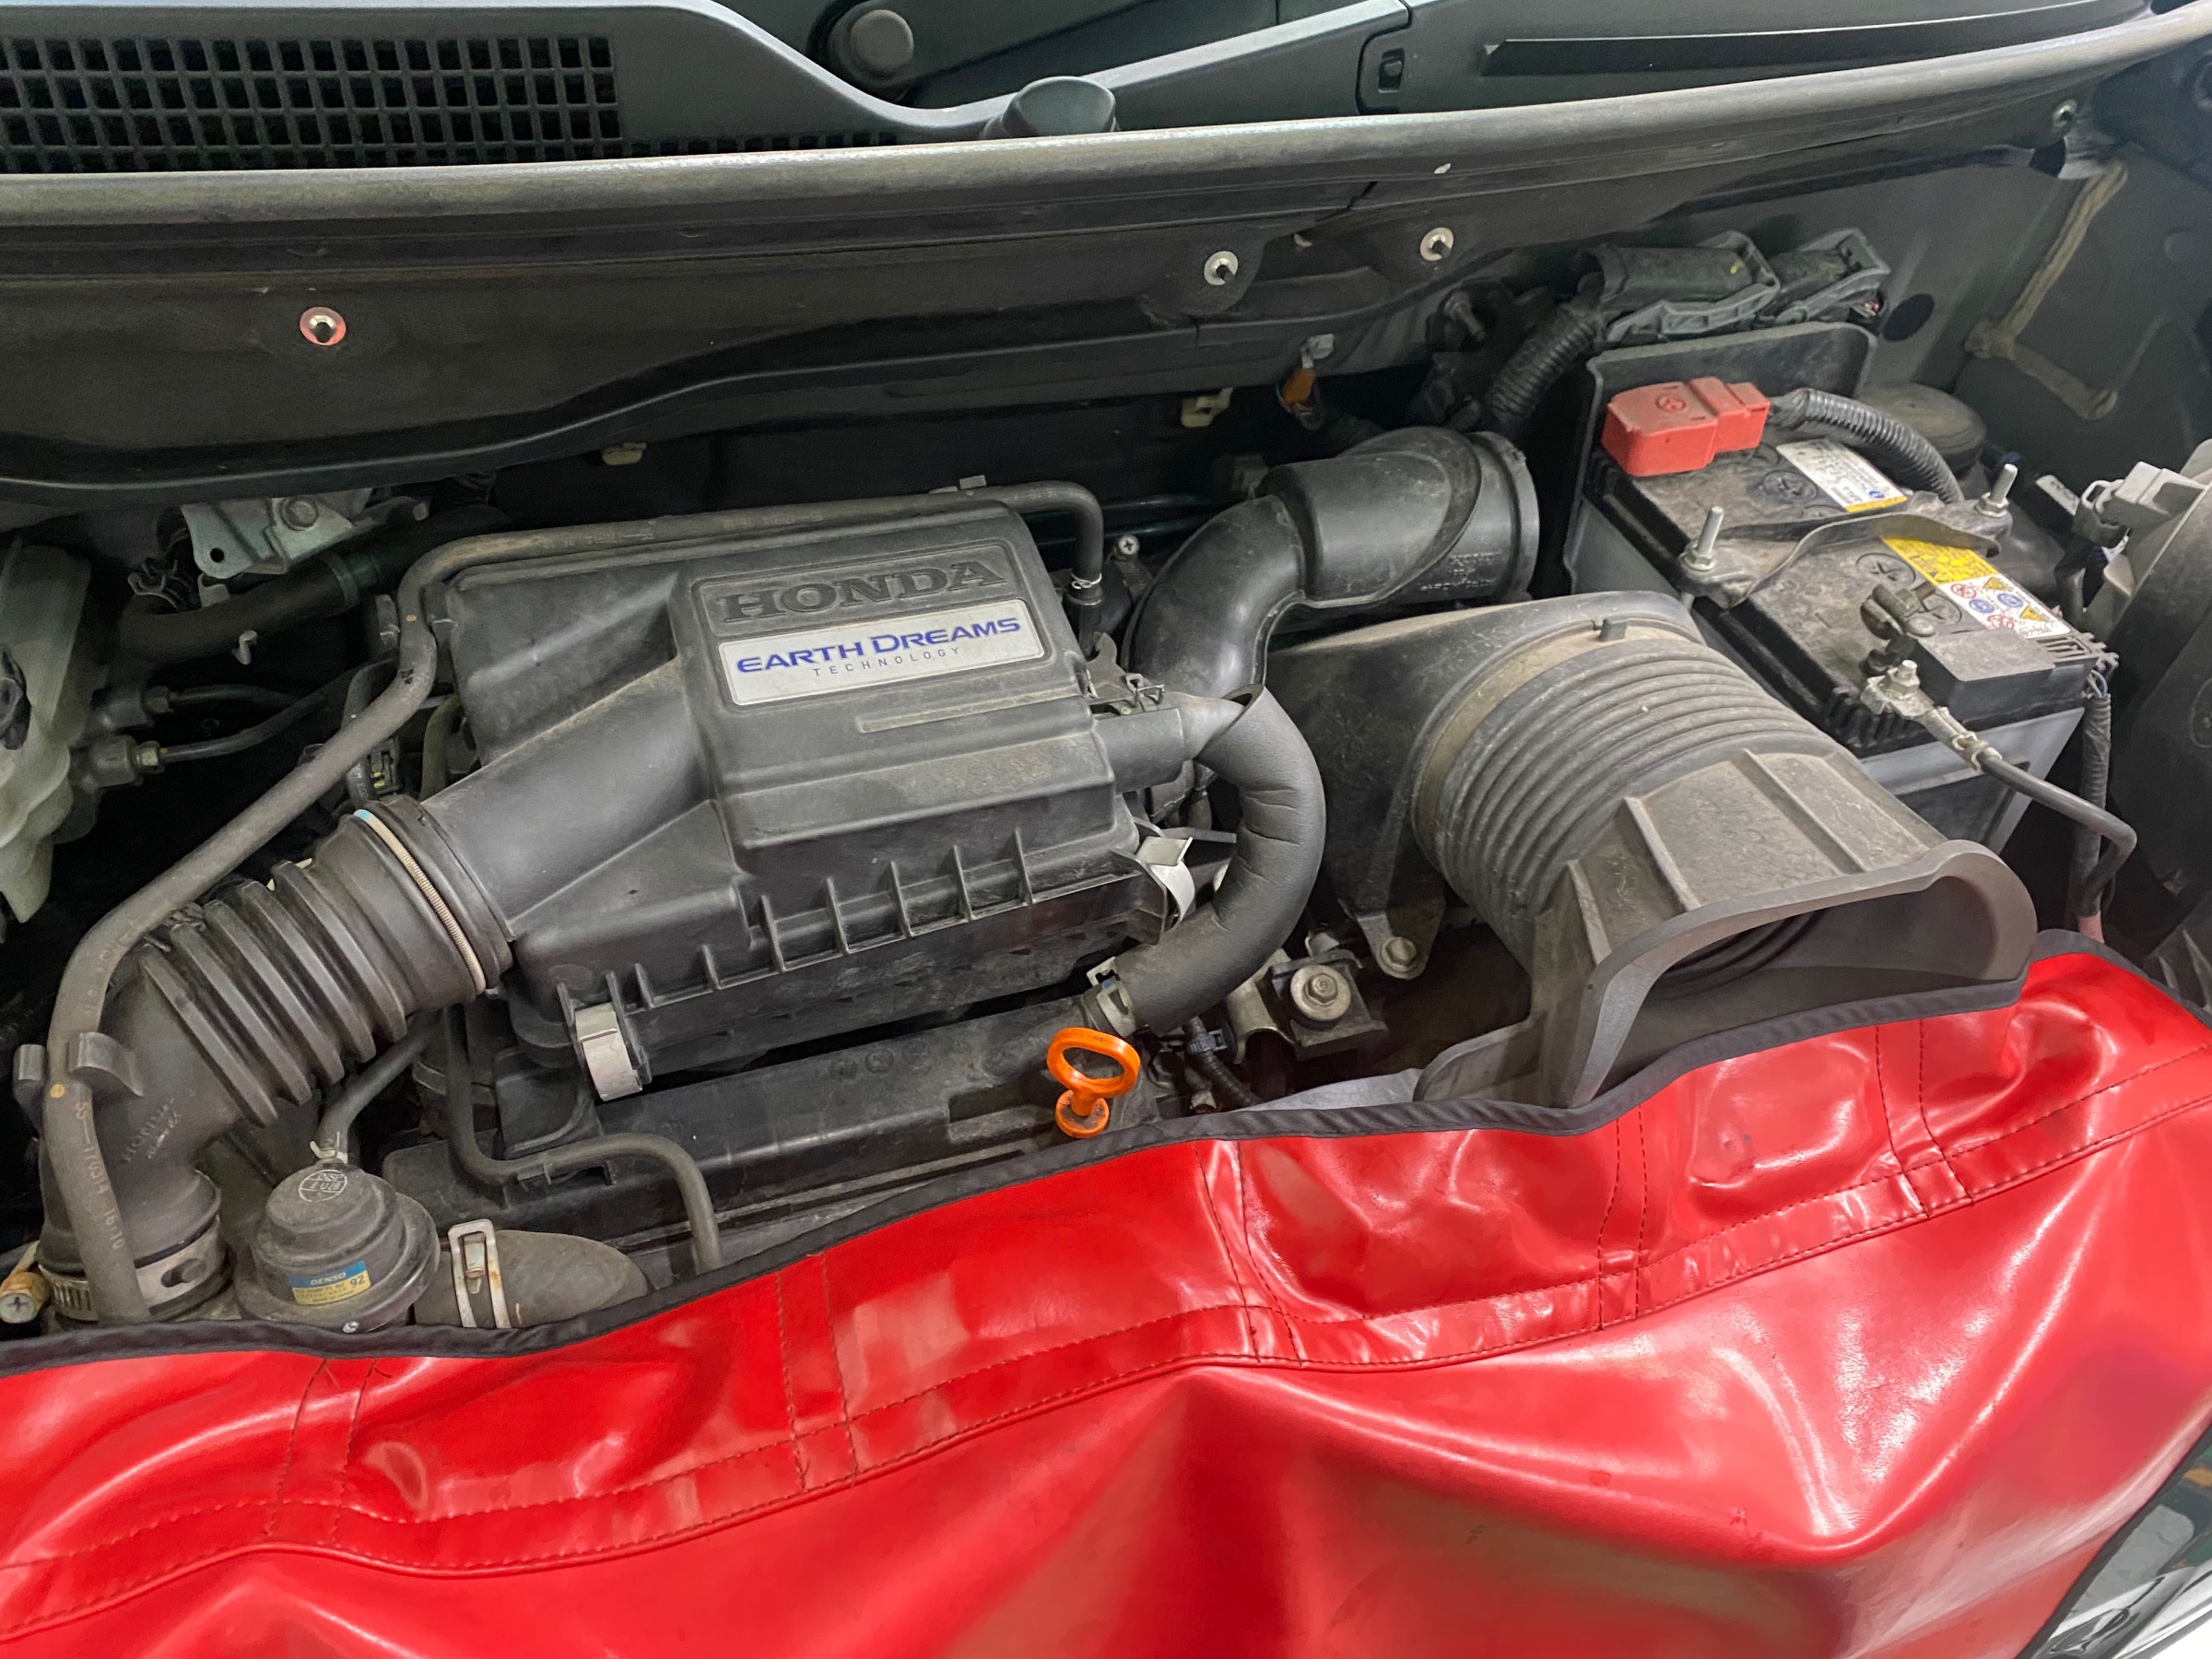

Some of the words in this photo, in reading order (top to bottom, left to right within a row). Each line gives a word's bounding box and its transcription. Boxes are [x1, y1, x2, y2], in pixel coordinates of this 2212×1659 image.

[719, 560, 1008, 623] HONDA
[736, 644, 865, 674] EARTH
[871, 617, 1021, 654] DREAMS
[813, 646, 960, 677] TECHNOLOGY
[310, 1271, 347, 1286] DENSO
